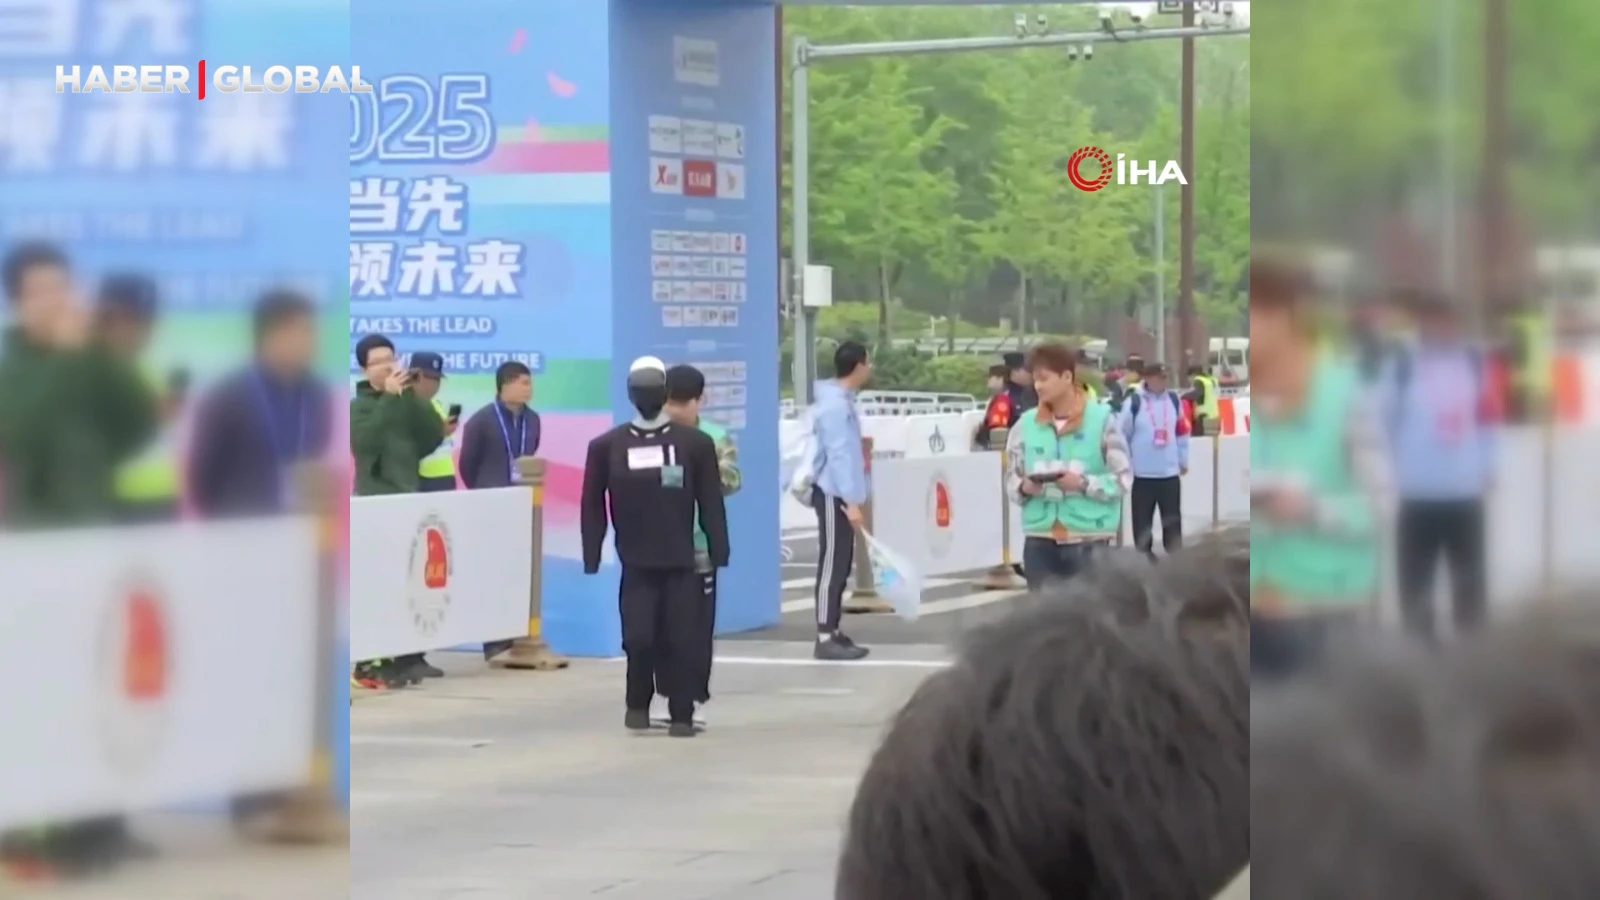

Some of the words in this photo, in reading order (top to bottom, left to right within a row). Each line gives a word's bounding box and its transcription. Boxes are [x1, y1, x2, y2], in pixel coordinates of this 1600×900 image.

[349, 177, 463, 232] 当先
[407, 317, 439, 333] THE
[444, 317, 492, 333] LEAD
[442, 353, 466, 369] HE
